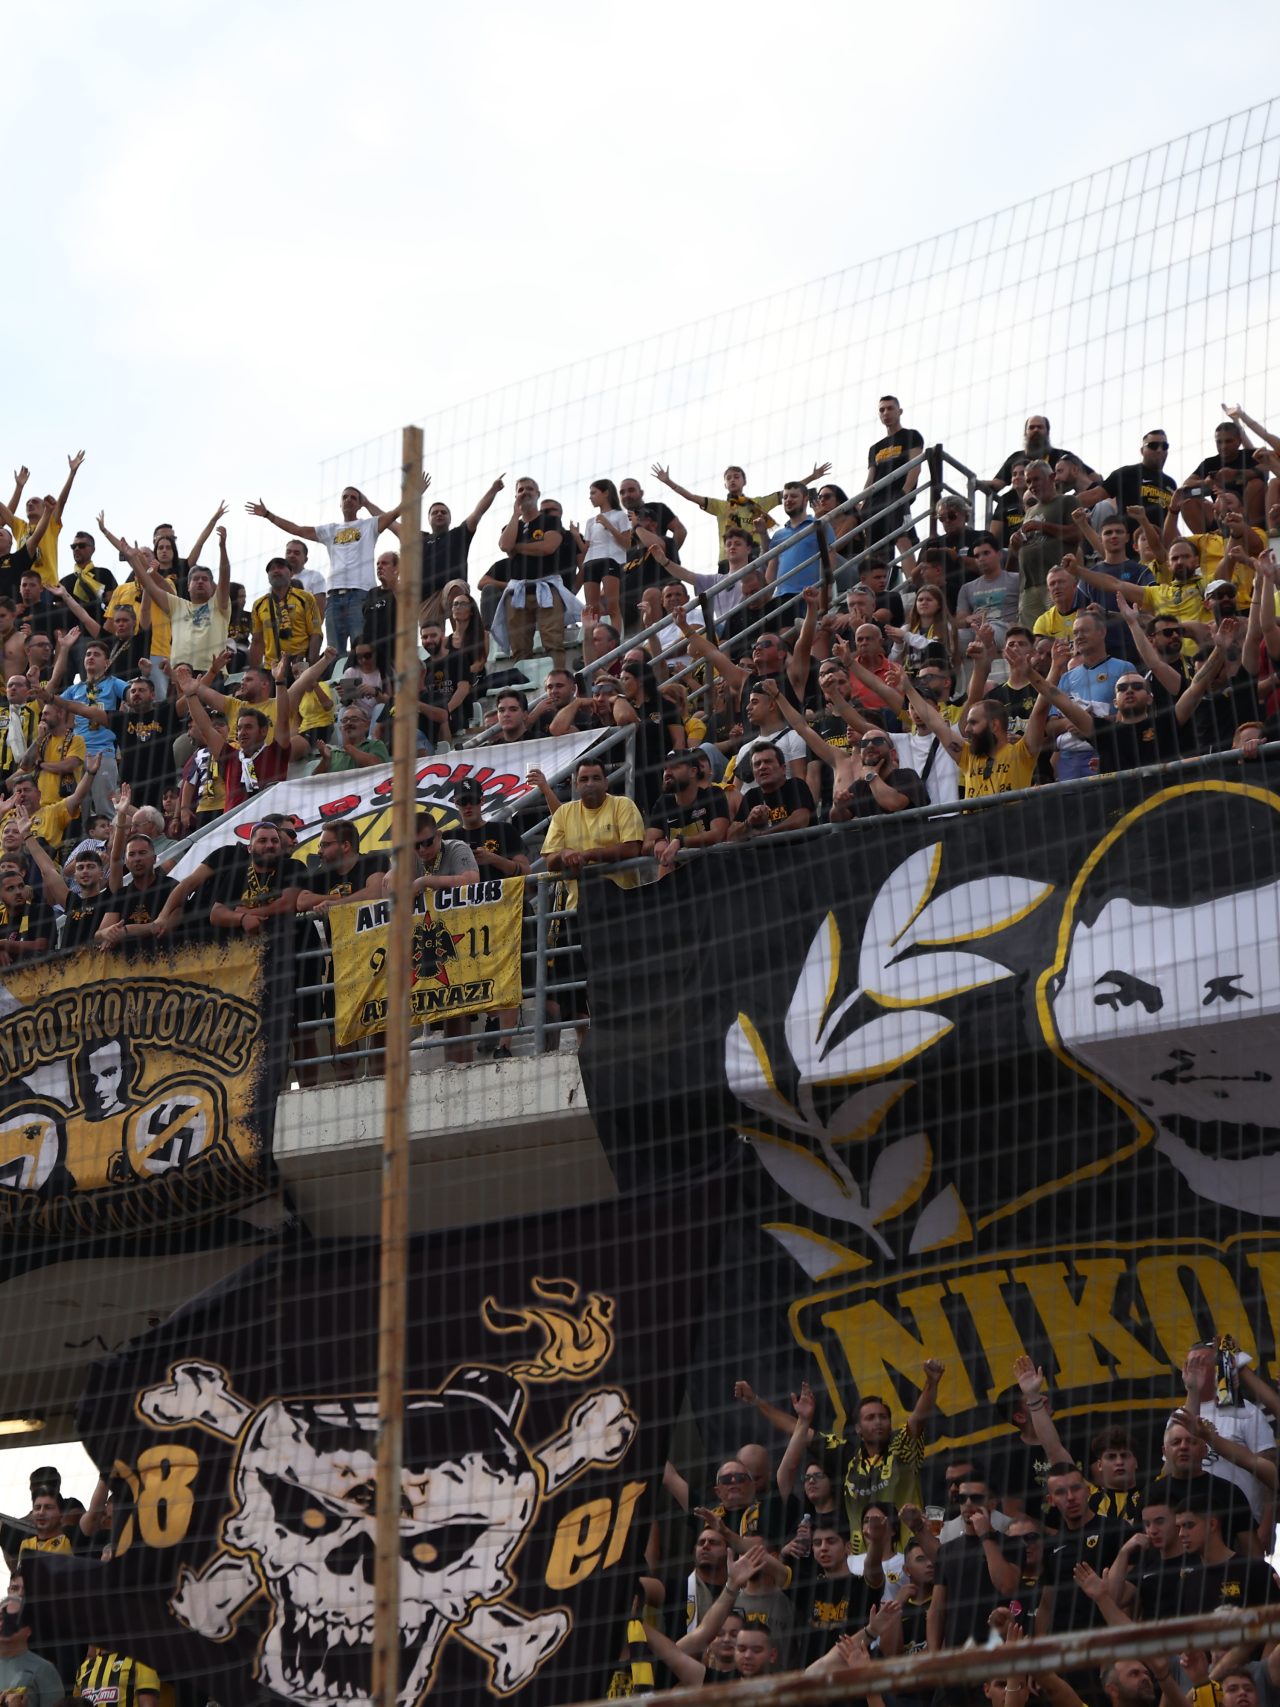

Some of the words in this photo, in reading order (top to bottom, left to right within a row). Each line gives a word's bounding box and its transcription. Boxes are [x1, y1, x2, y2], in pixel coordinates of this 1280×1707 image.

[356, 892, 426, 934] ARA
[434, 880, 503, 912] CLUB
[467, 924, 492, 959] 11
[362, 981, 491, 1024] AINAZI
